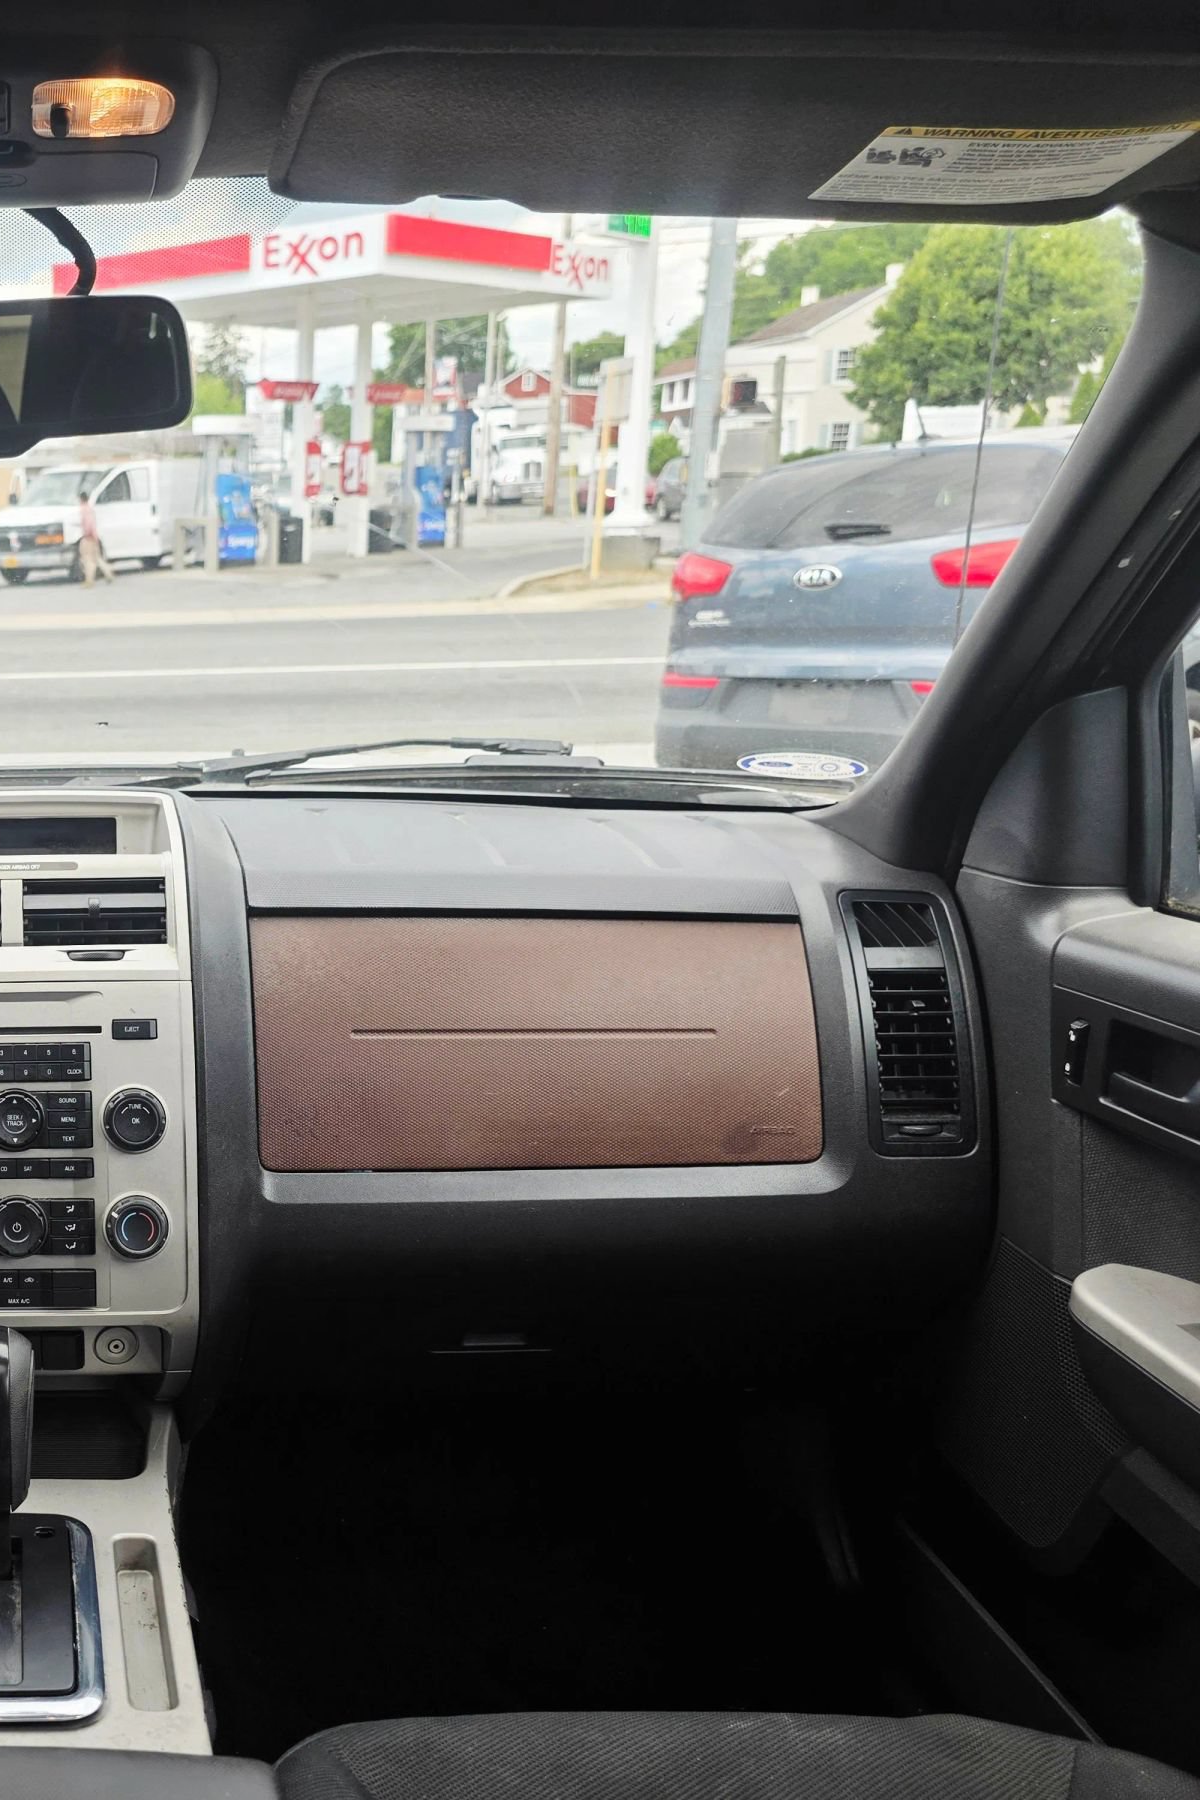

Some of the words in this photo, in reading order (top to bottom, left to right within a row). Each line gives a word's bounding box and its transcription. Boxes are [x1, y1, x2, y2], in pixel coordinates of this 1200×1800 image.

[923, 128, 1016, 138] WARNING
[264, 231, 363, 276] Exxon
[552, 244, 609, 290] Exxon
[124, 1025, 140, 1033] EJECT
[131, 1117, 140, 1125] OK
[749, 1125, 795, 1135] AIRBAG
